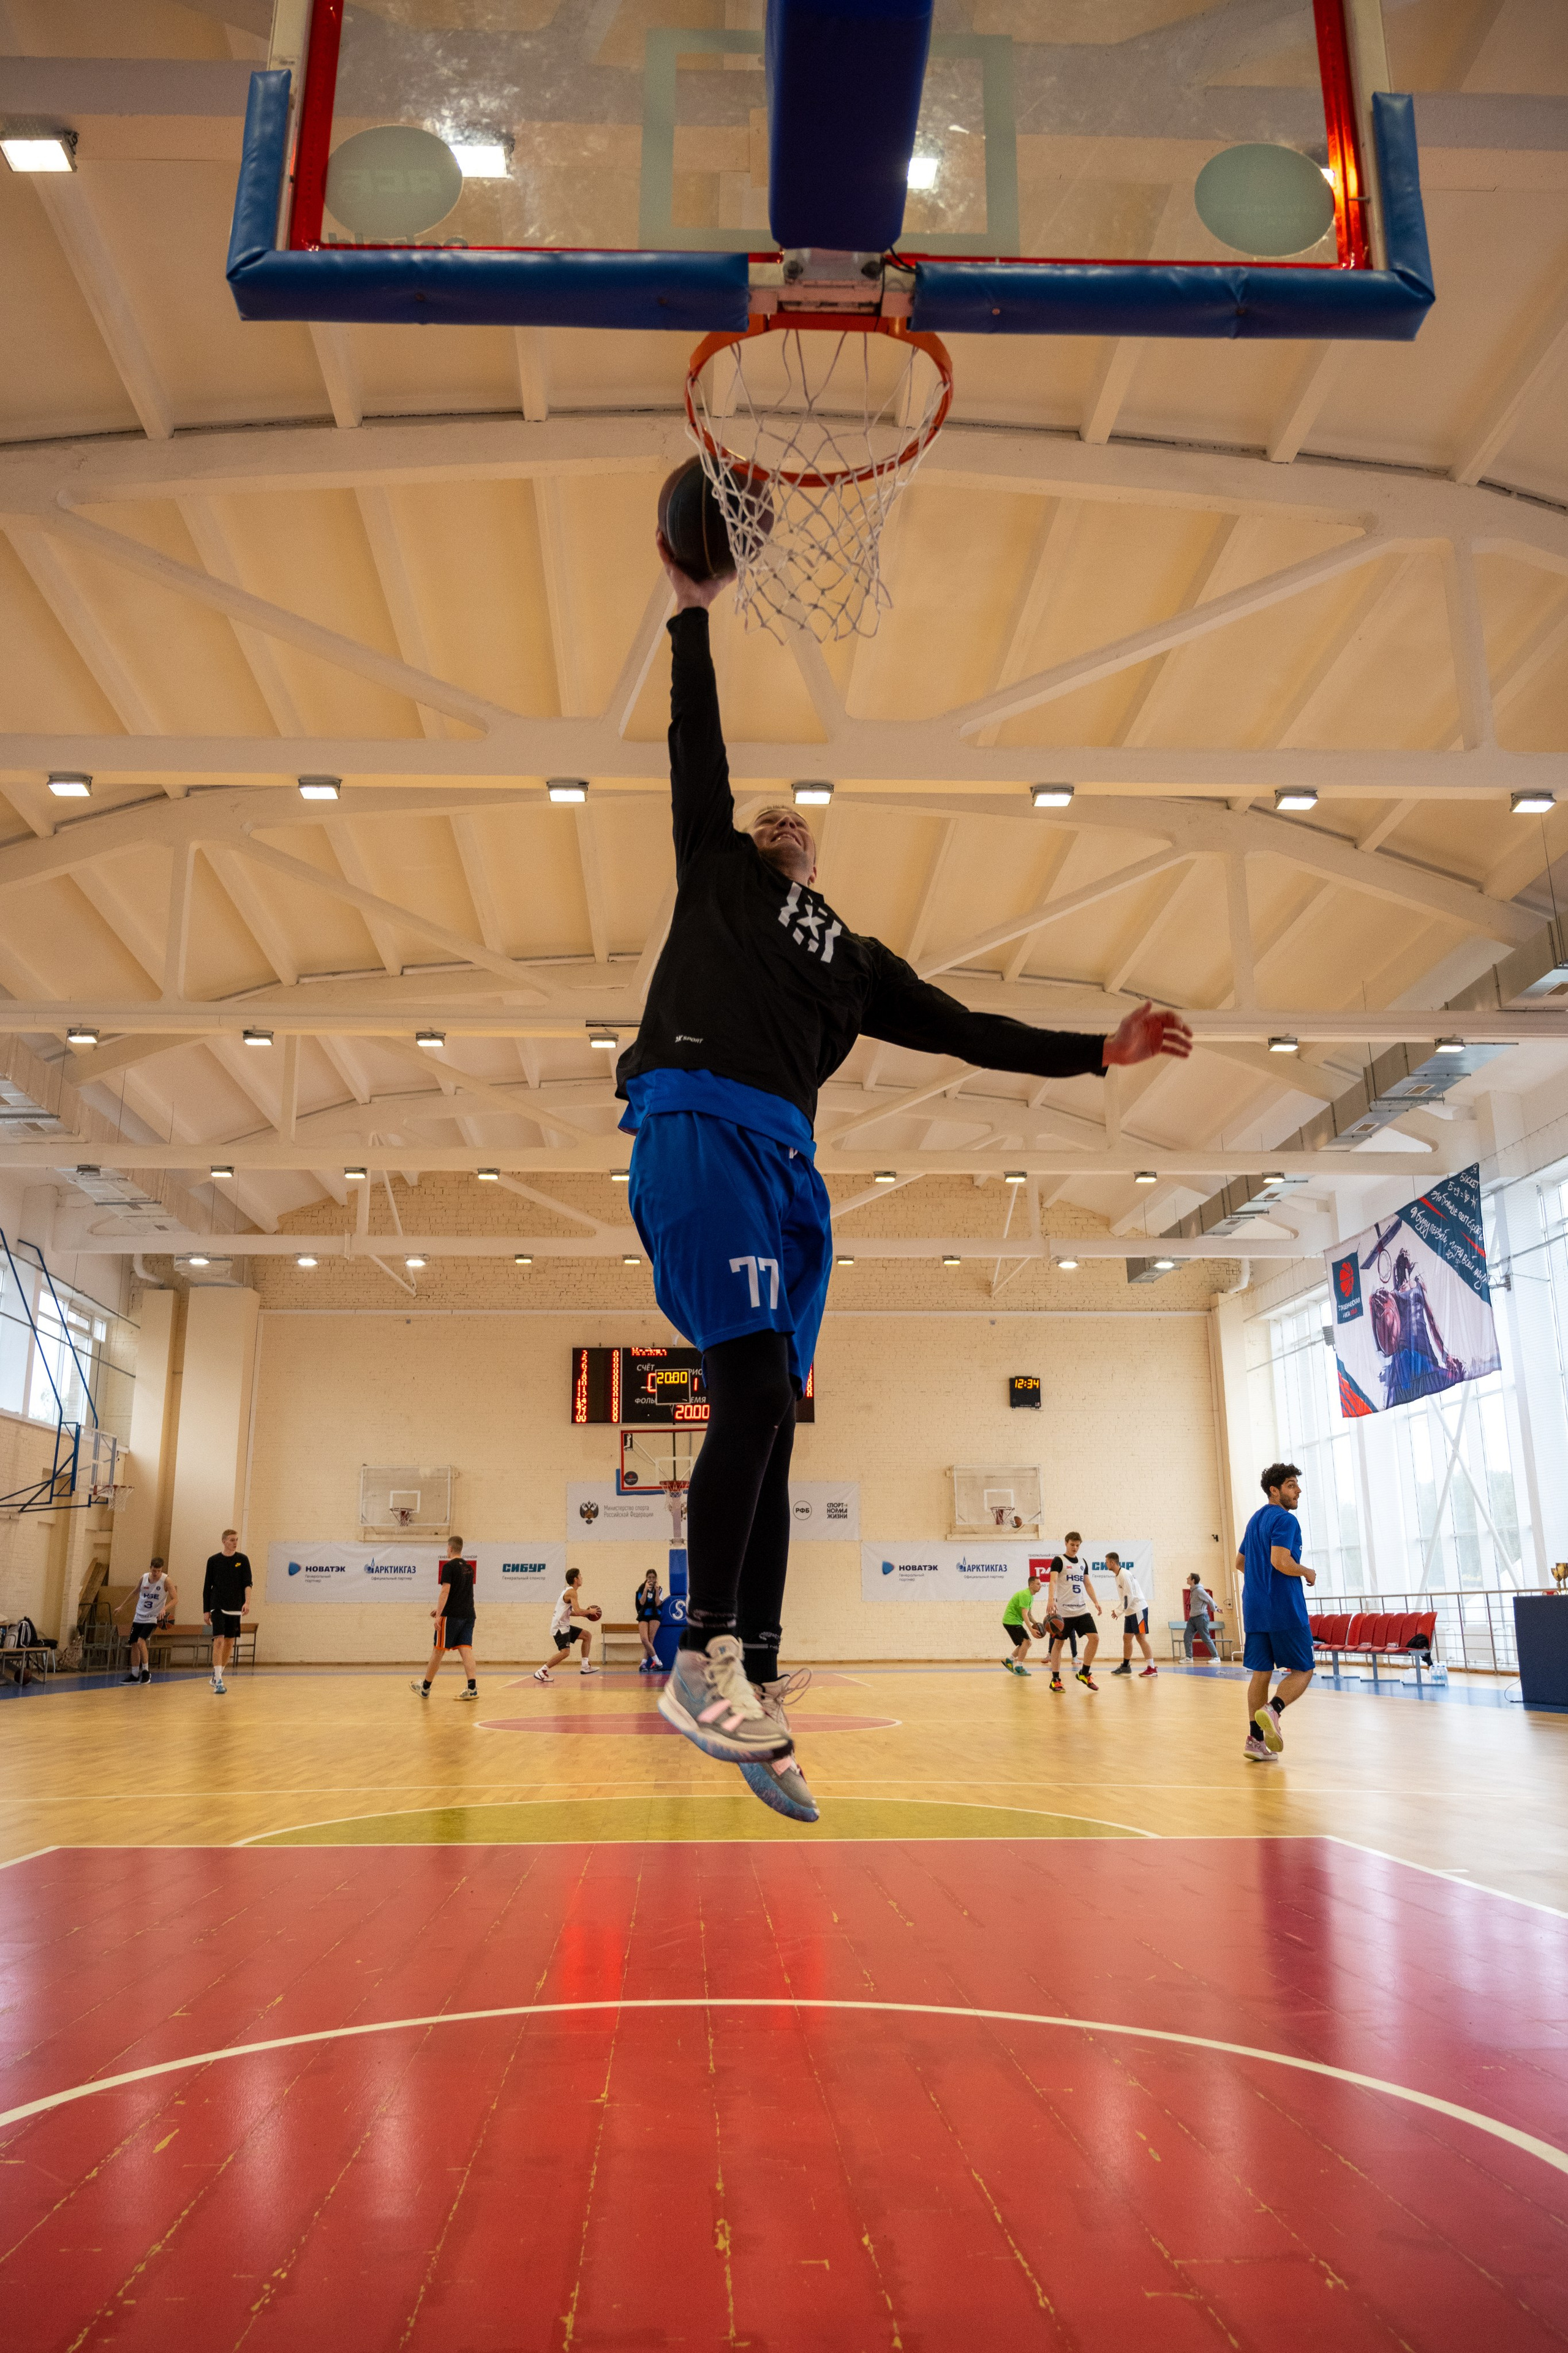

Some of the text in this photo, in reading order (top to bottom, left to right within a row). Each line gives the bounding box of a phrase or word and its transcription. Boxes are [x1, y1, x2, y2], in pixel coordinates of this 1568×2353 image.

[729, 1256, 779, 1310] 77
[1015, 1379, 1039, 1389] 12:34
[502, 1563, 546, 1572] СИБУР
[1072, 1585, 1081, 1594] 5
